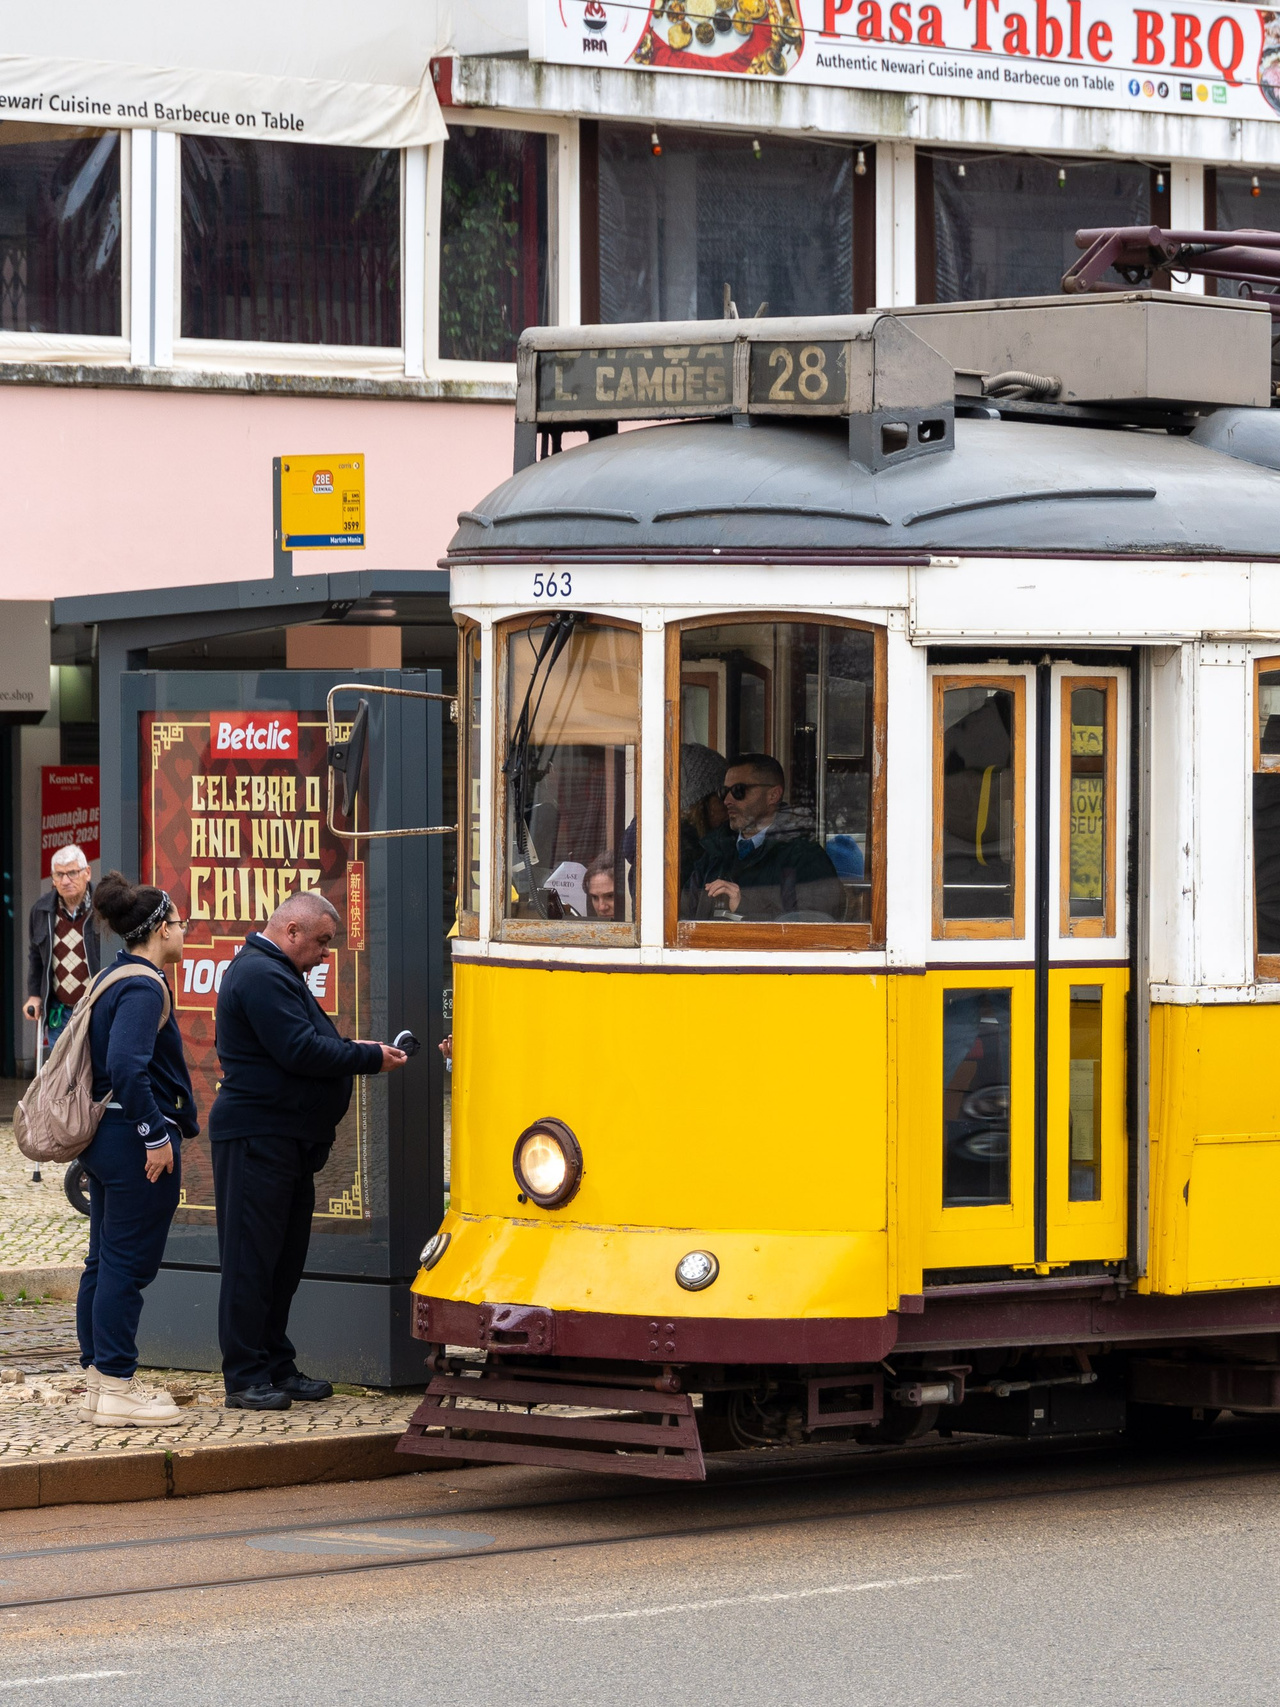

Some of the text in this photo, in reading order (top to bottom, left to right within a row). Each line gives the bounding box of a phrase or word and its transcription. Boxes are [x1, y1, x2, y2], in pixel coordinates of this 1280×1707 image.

[819, 0, 1244, 87] Pasa Table BBQ
[816, 53, 1115, 91] Authentic Newari Cuisine and Barbecue on Table
[49, 94, 112, 115] Cuisine
[117, 101, 149, 119] and
[154, 103, 230, 125] Barbecue
[235, 113, 256, 127] on
[261, 112, 305, 132] Table
[554, 362, 726, 403] L. CAMÕES
[768, 345, 829, 400] 28
[315, 474, 331, 485] 28E
[343, 522, 359, 531] 3599
[533, 572, 572, 597] 563
[217, 719, 292, 751] Betclic
[49, 773, 94, 784] Kamal Tec
[191, 775, 320, 817] CELEBRA O
[42, 807, 100, 829] LIQUIDAÇÃO DE
[42, 825, 99, 849] STOCKS 2024
[191, 818, 320, 859] ANO NOVO
[350, 873, 361, 938] 新年快乐
